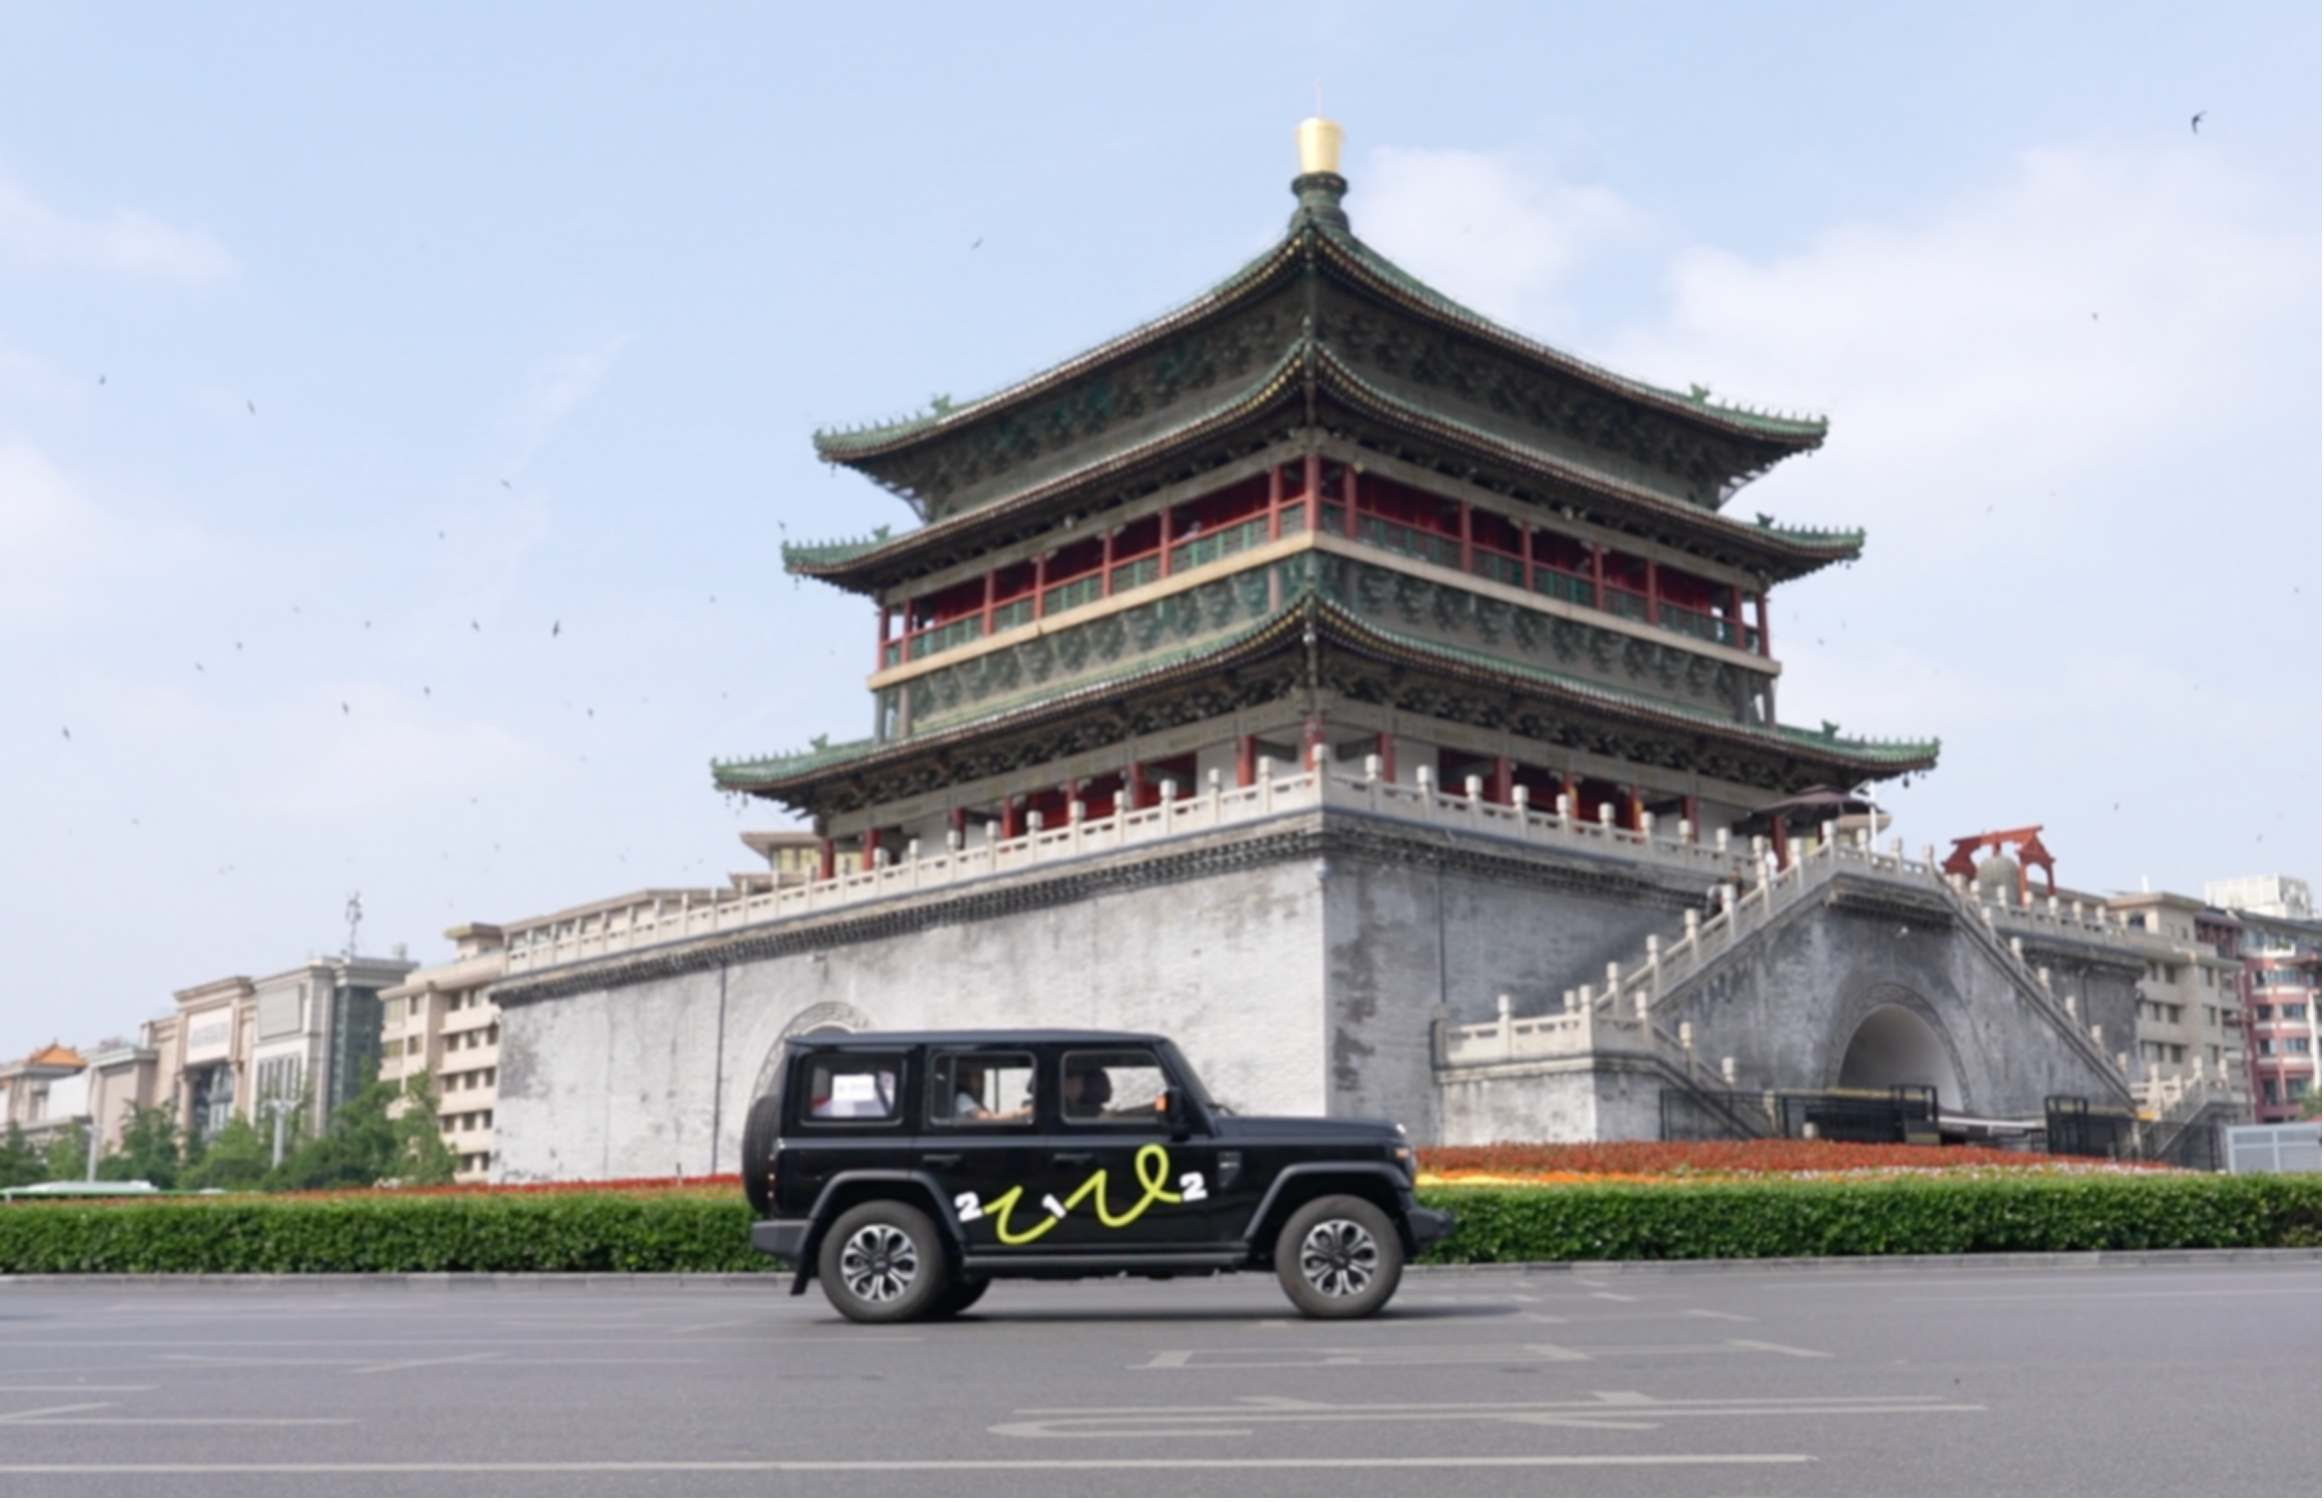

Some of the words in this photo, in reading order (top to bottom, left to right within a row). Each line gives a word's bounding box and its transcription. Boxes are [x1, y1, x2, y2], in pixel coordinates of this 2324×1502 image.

[954, 1191, 984, 1222] 2
[1041, 1193, 1067, 1219] 1
[1178, 1171, 1208, 1202] 2
[986, 1390, 1990, 1438] 北
